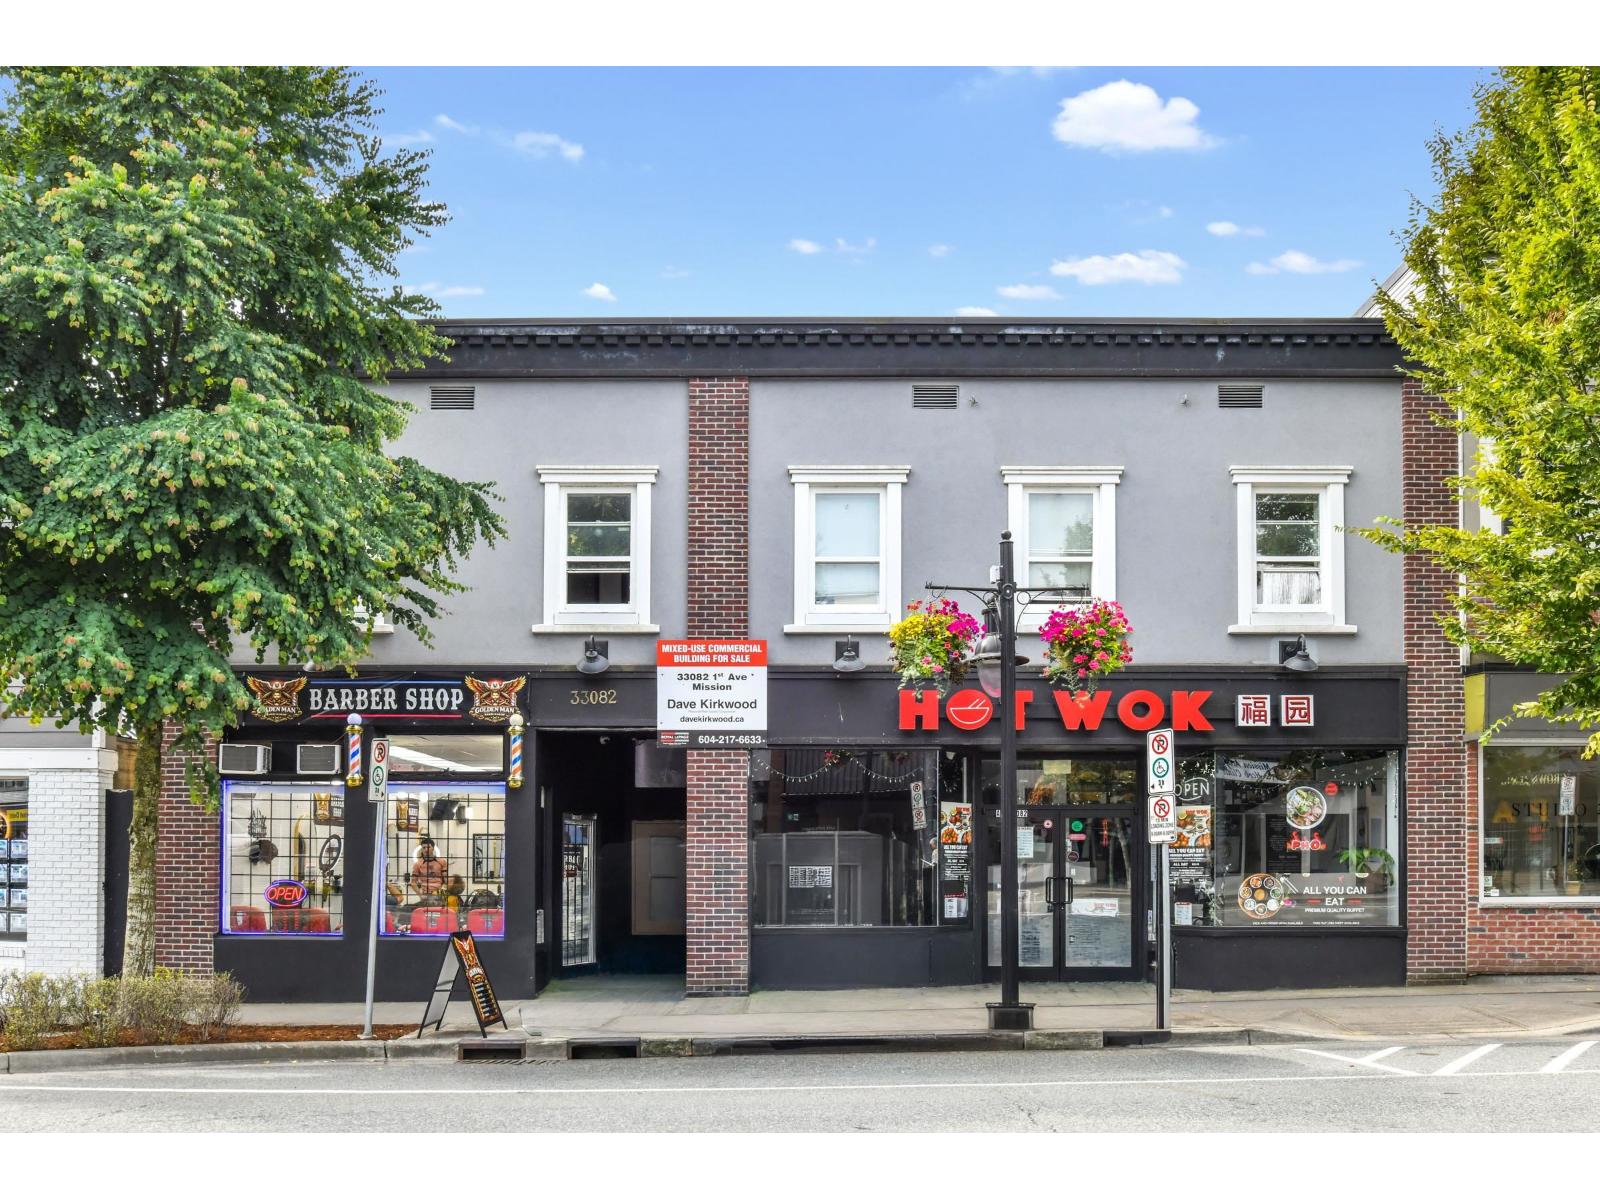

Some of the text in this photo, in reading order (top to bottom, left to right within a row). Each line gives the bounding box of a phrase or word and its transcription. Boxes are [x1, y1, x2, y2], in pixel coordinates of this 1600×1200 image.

[662, 644, 762, 652] MIXED-USE COMMERCIAL
[674, 654, 750, 662] BUILDING FOR SALE
[712, 672, 724, 681] 1st
[310, 688, 463, 710] BARBER SHOP
[570, 690, 617, 704] 33082
[667, 699, 757, 709] Dave Kirkwood
[1053, 690, 1215, 730] WOK
[1241, 696, 1310, 725] 福园
[698, 736, 761, 744] 604-217-6633
[1175, 781, 1209, 798] OPEN
[267, 887, 302, 900] OPEN
[1303, 886, 1367, 895] ALL YOU CAN
